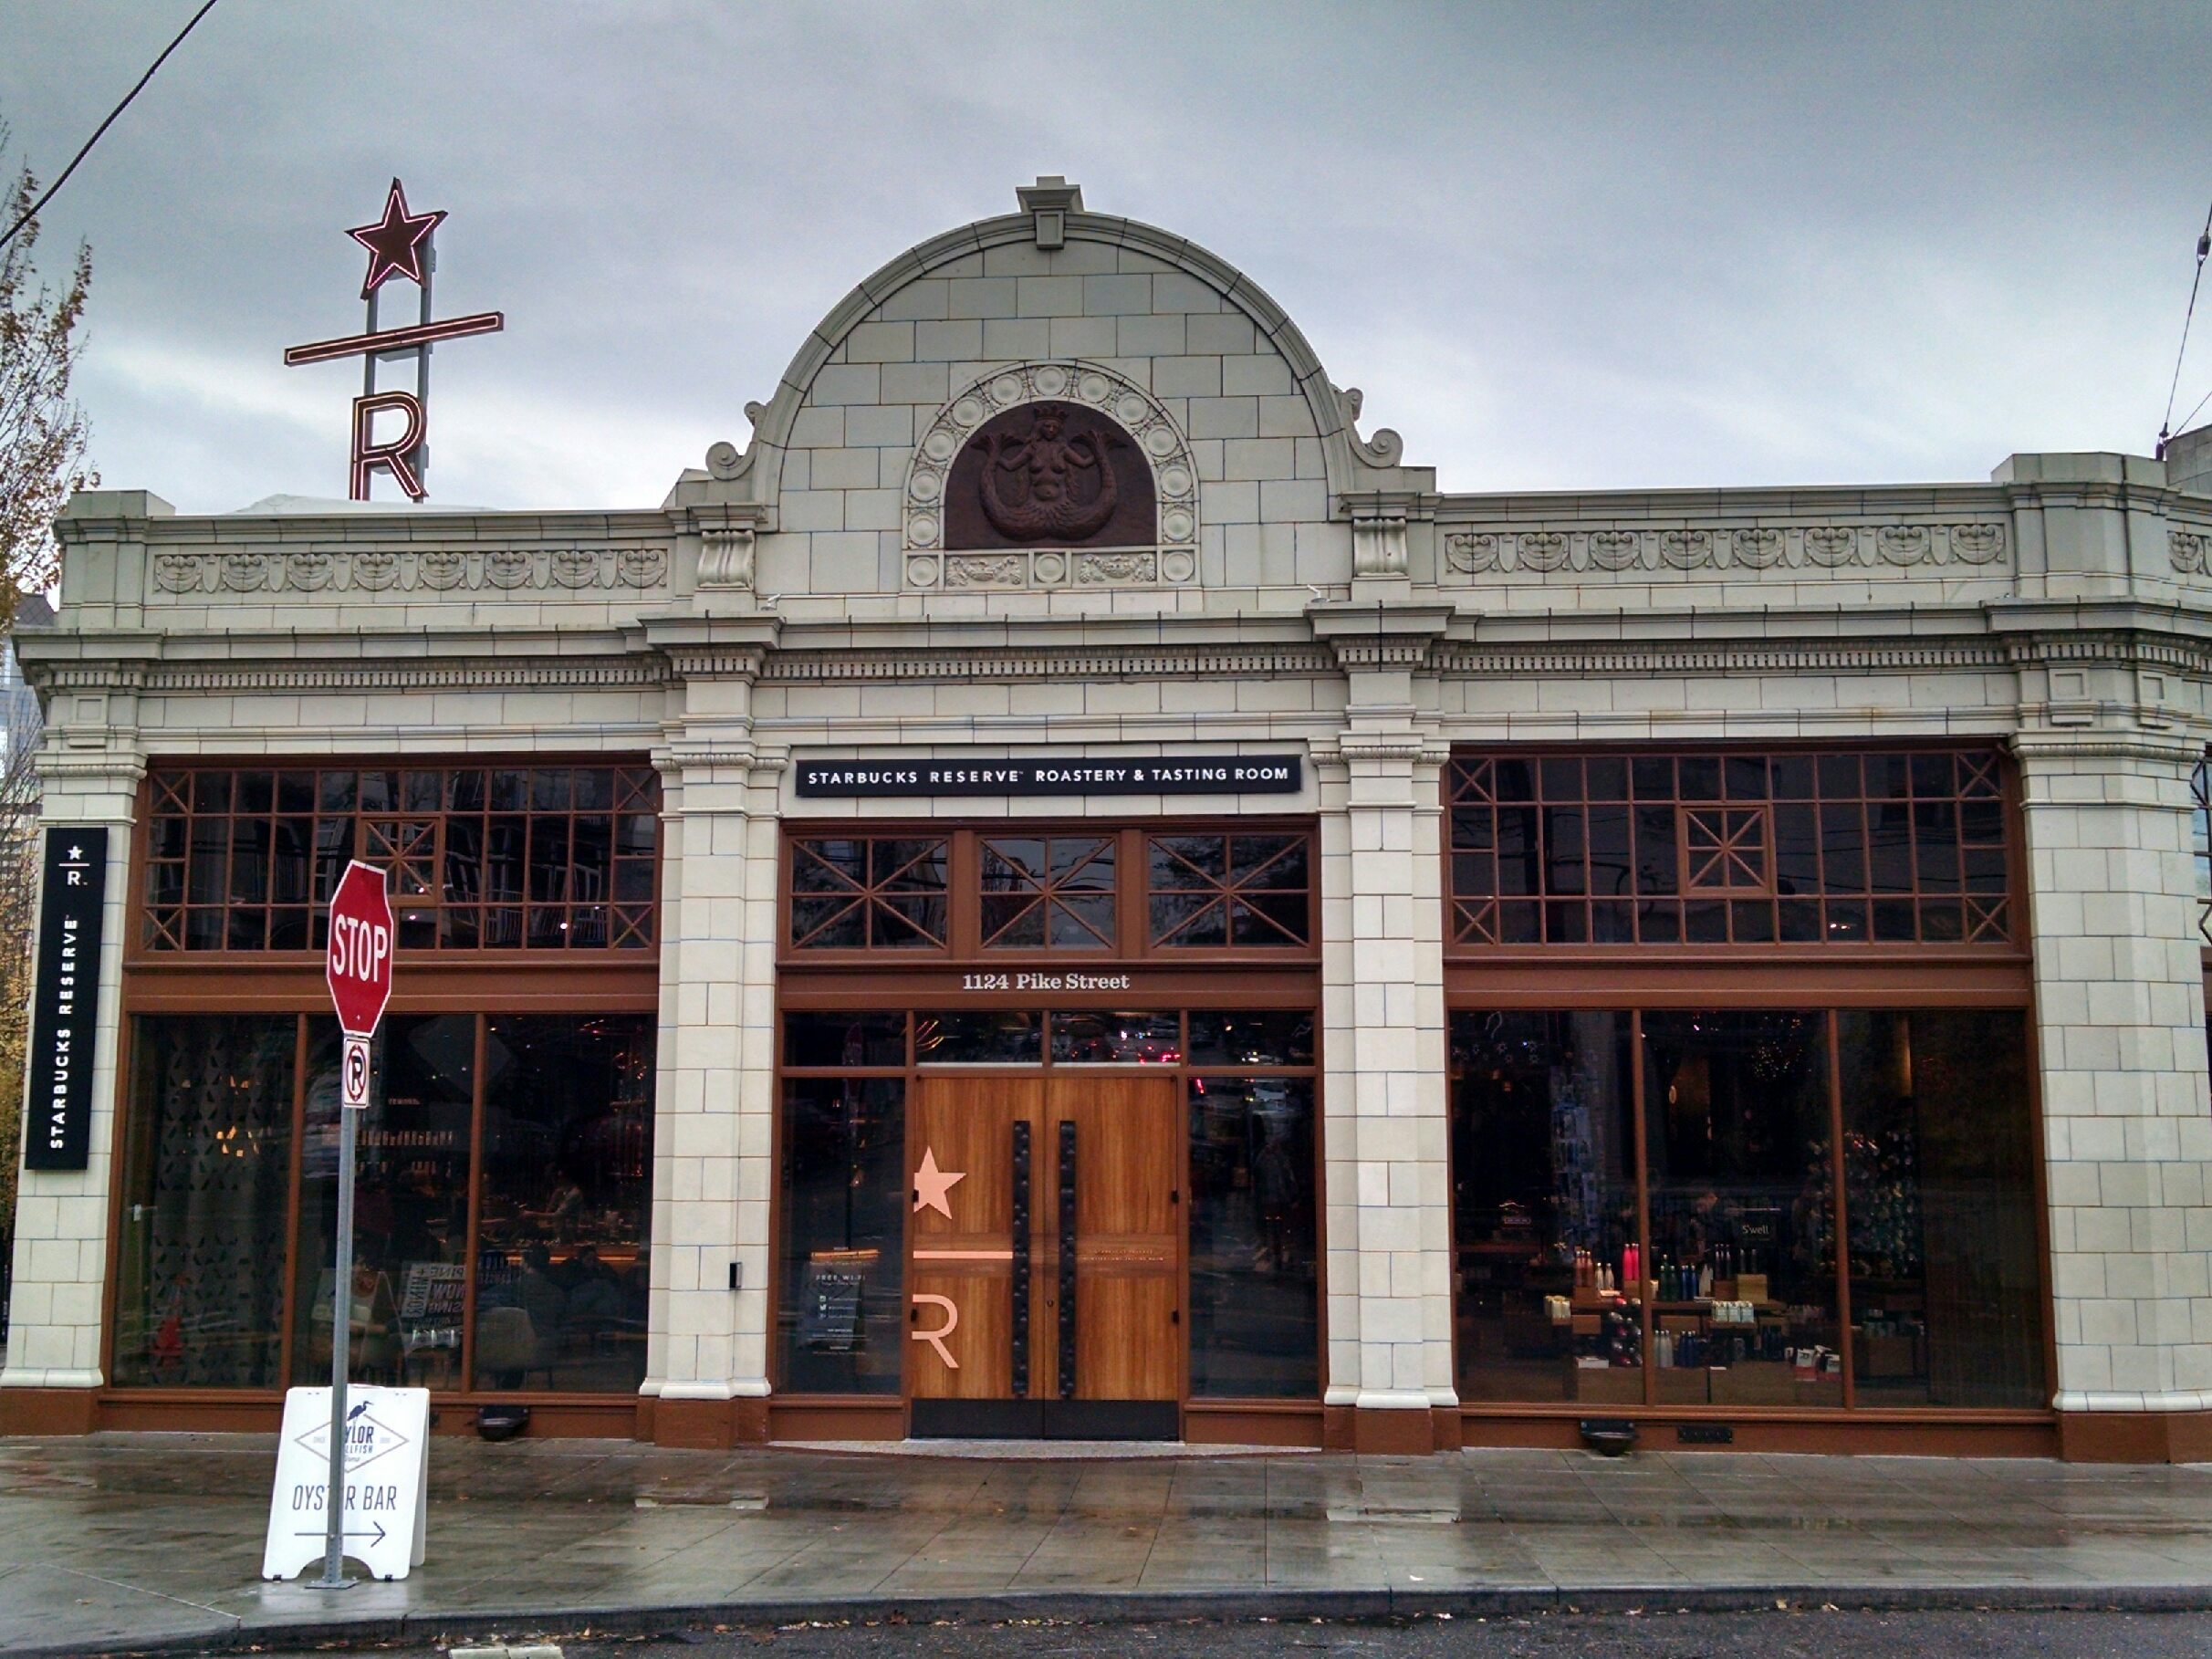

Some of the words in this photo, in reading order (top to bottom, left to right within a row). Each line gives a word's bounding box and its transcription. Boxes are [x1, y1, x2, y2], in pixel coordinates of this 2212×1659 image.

[349, 391, 429, 501] R
[809, 771, 917, 785] STARBUCKS
[1035, 769, 1127, 782] ROASTERY
[1133, 769, 1144, 781] &
[1152, 768, 1227, 781] TASTING
[1234, 767, 1289, 780] ROOM
[67, 871, 81, 886] R
[332, 913, 389, 982] STOP
[963, 974, 1009, 990] 1124
[1016, 973, 1062, 990] Pike
[1065, 973, 1130, 990] Street
[50, 1028, 72, 1150] STARBUCKS
[292, 1484, 356, 1511] OYSR
[362, 1485, 397, 1510] BAR
